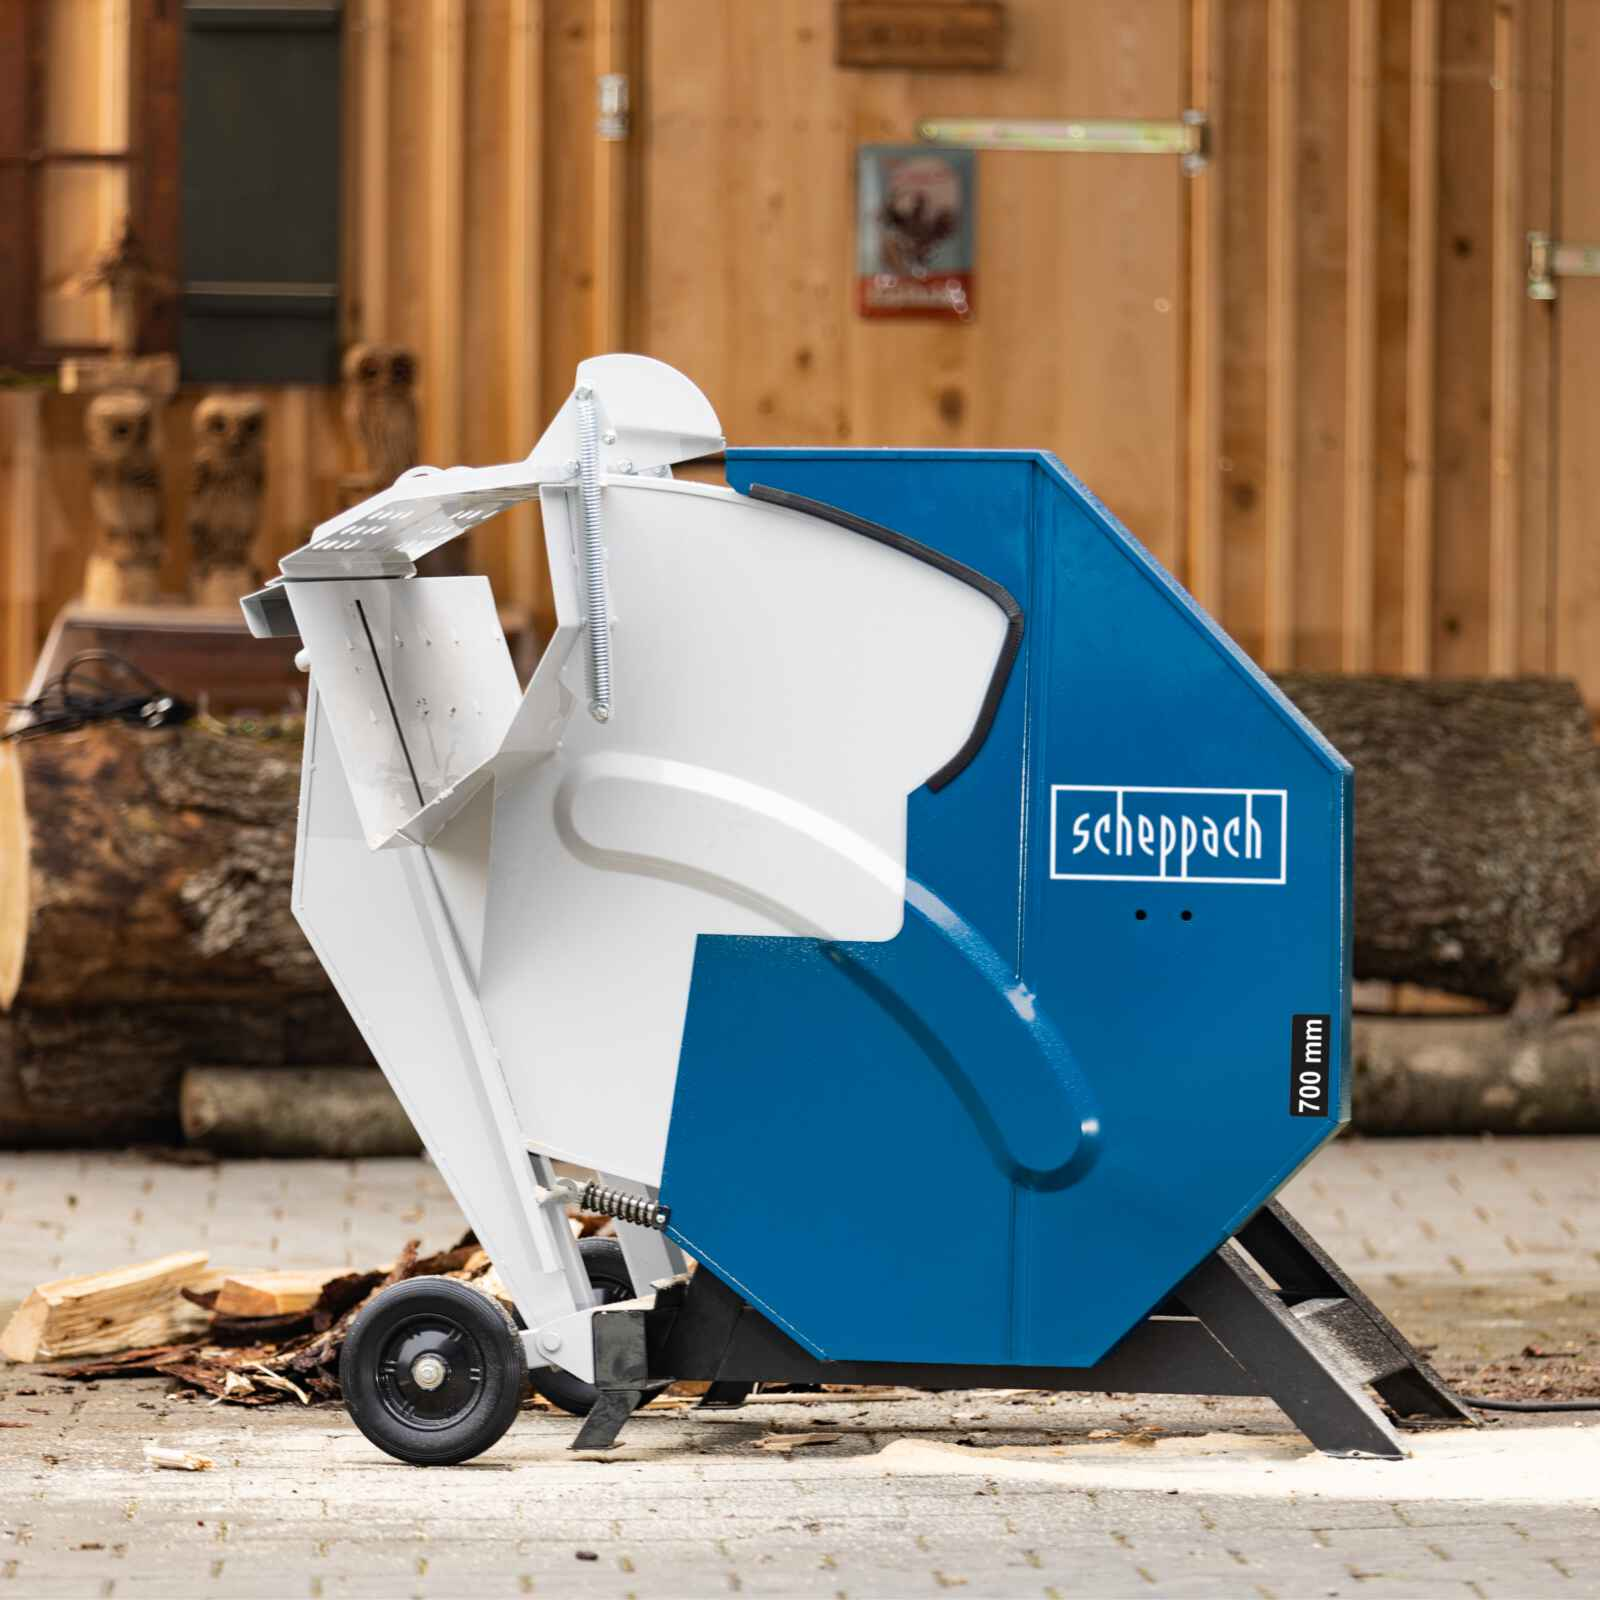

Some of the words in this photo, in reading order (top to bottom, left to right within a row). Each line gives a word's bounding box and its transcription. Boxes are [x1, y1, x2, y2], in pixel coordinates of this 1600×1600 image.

[1072, 790, 1262, 877] scheppach
[1305, 1019, 1323, 1063] mm
[1298, 1071, 1321, 1113] 700
